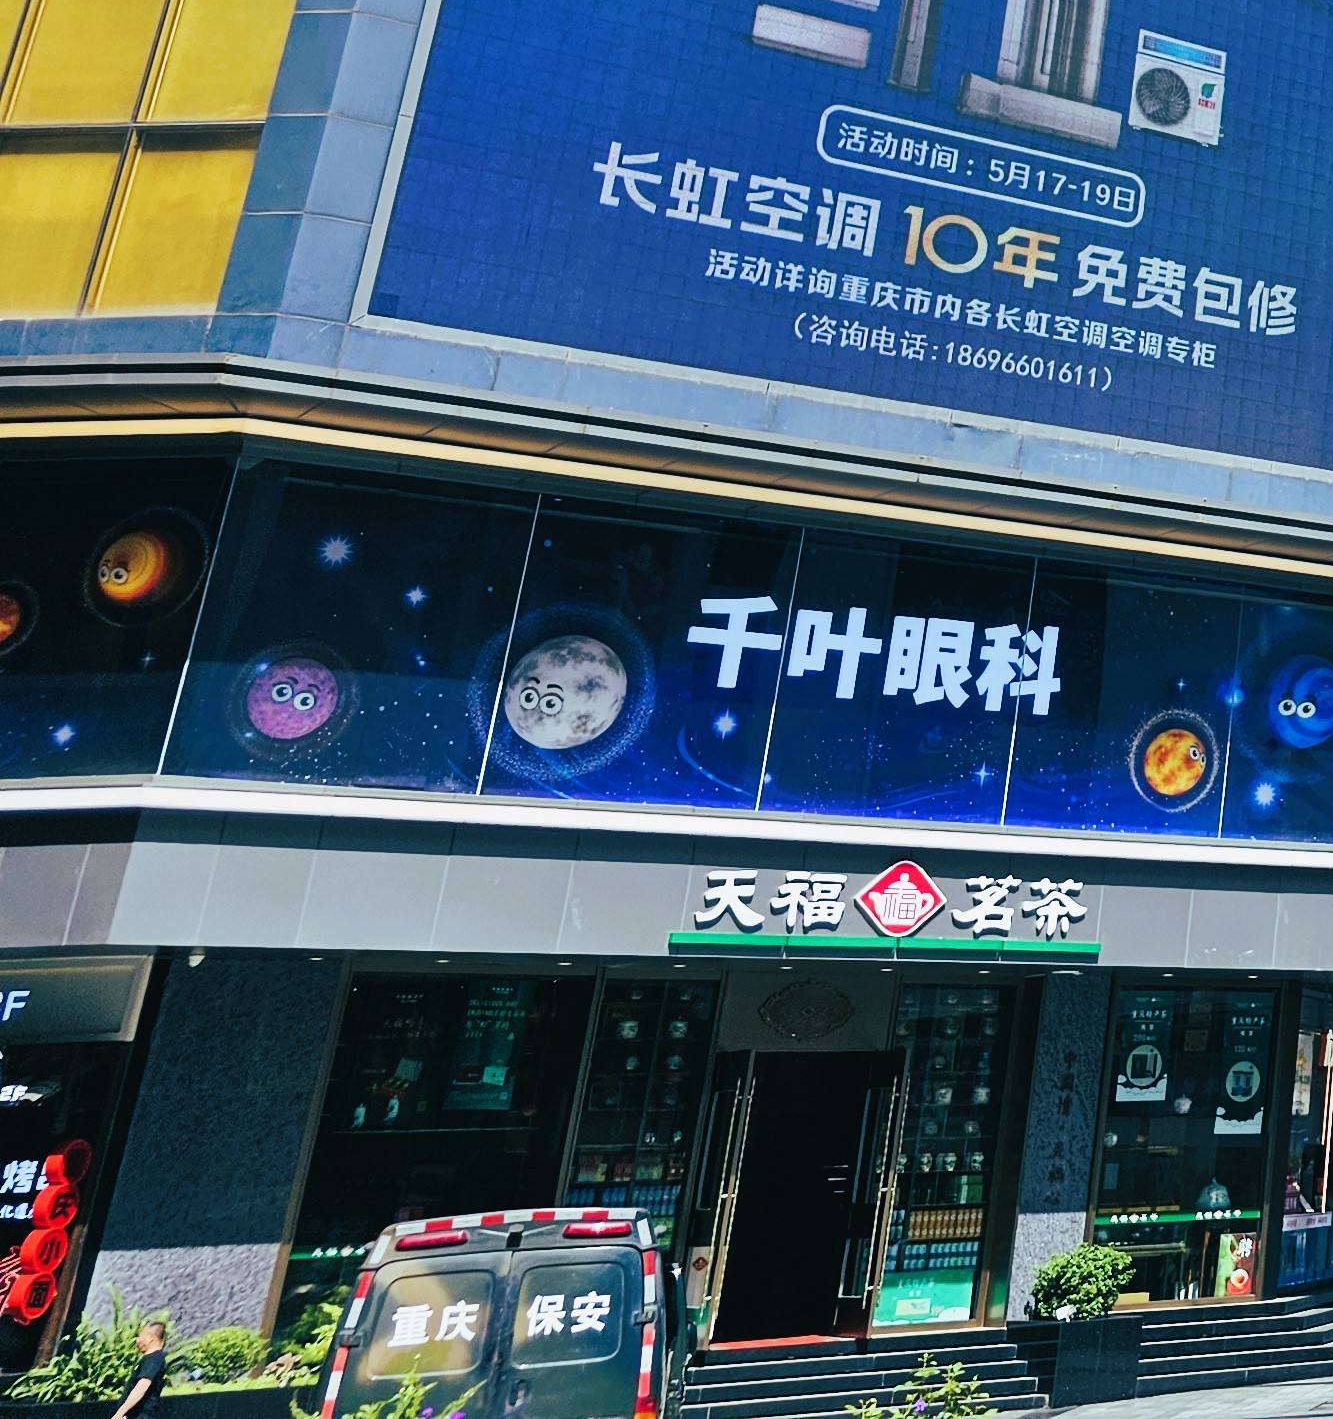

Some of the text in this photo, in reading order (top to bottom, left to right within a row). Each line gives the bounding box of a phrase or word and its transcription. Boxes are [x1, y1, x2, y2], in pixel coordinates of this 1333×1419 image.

[704, 249, 1217, 370] 活动详询重庆市内各长虹空调空调专柜
[686, 595, 1062, 716] 千叶眼科
[386, 1290, 611, 1348] 重庆 保安
